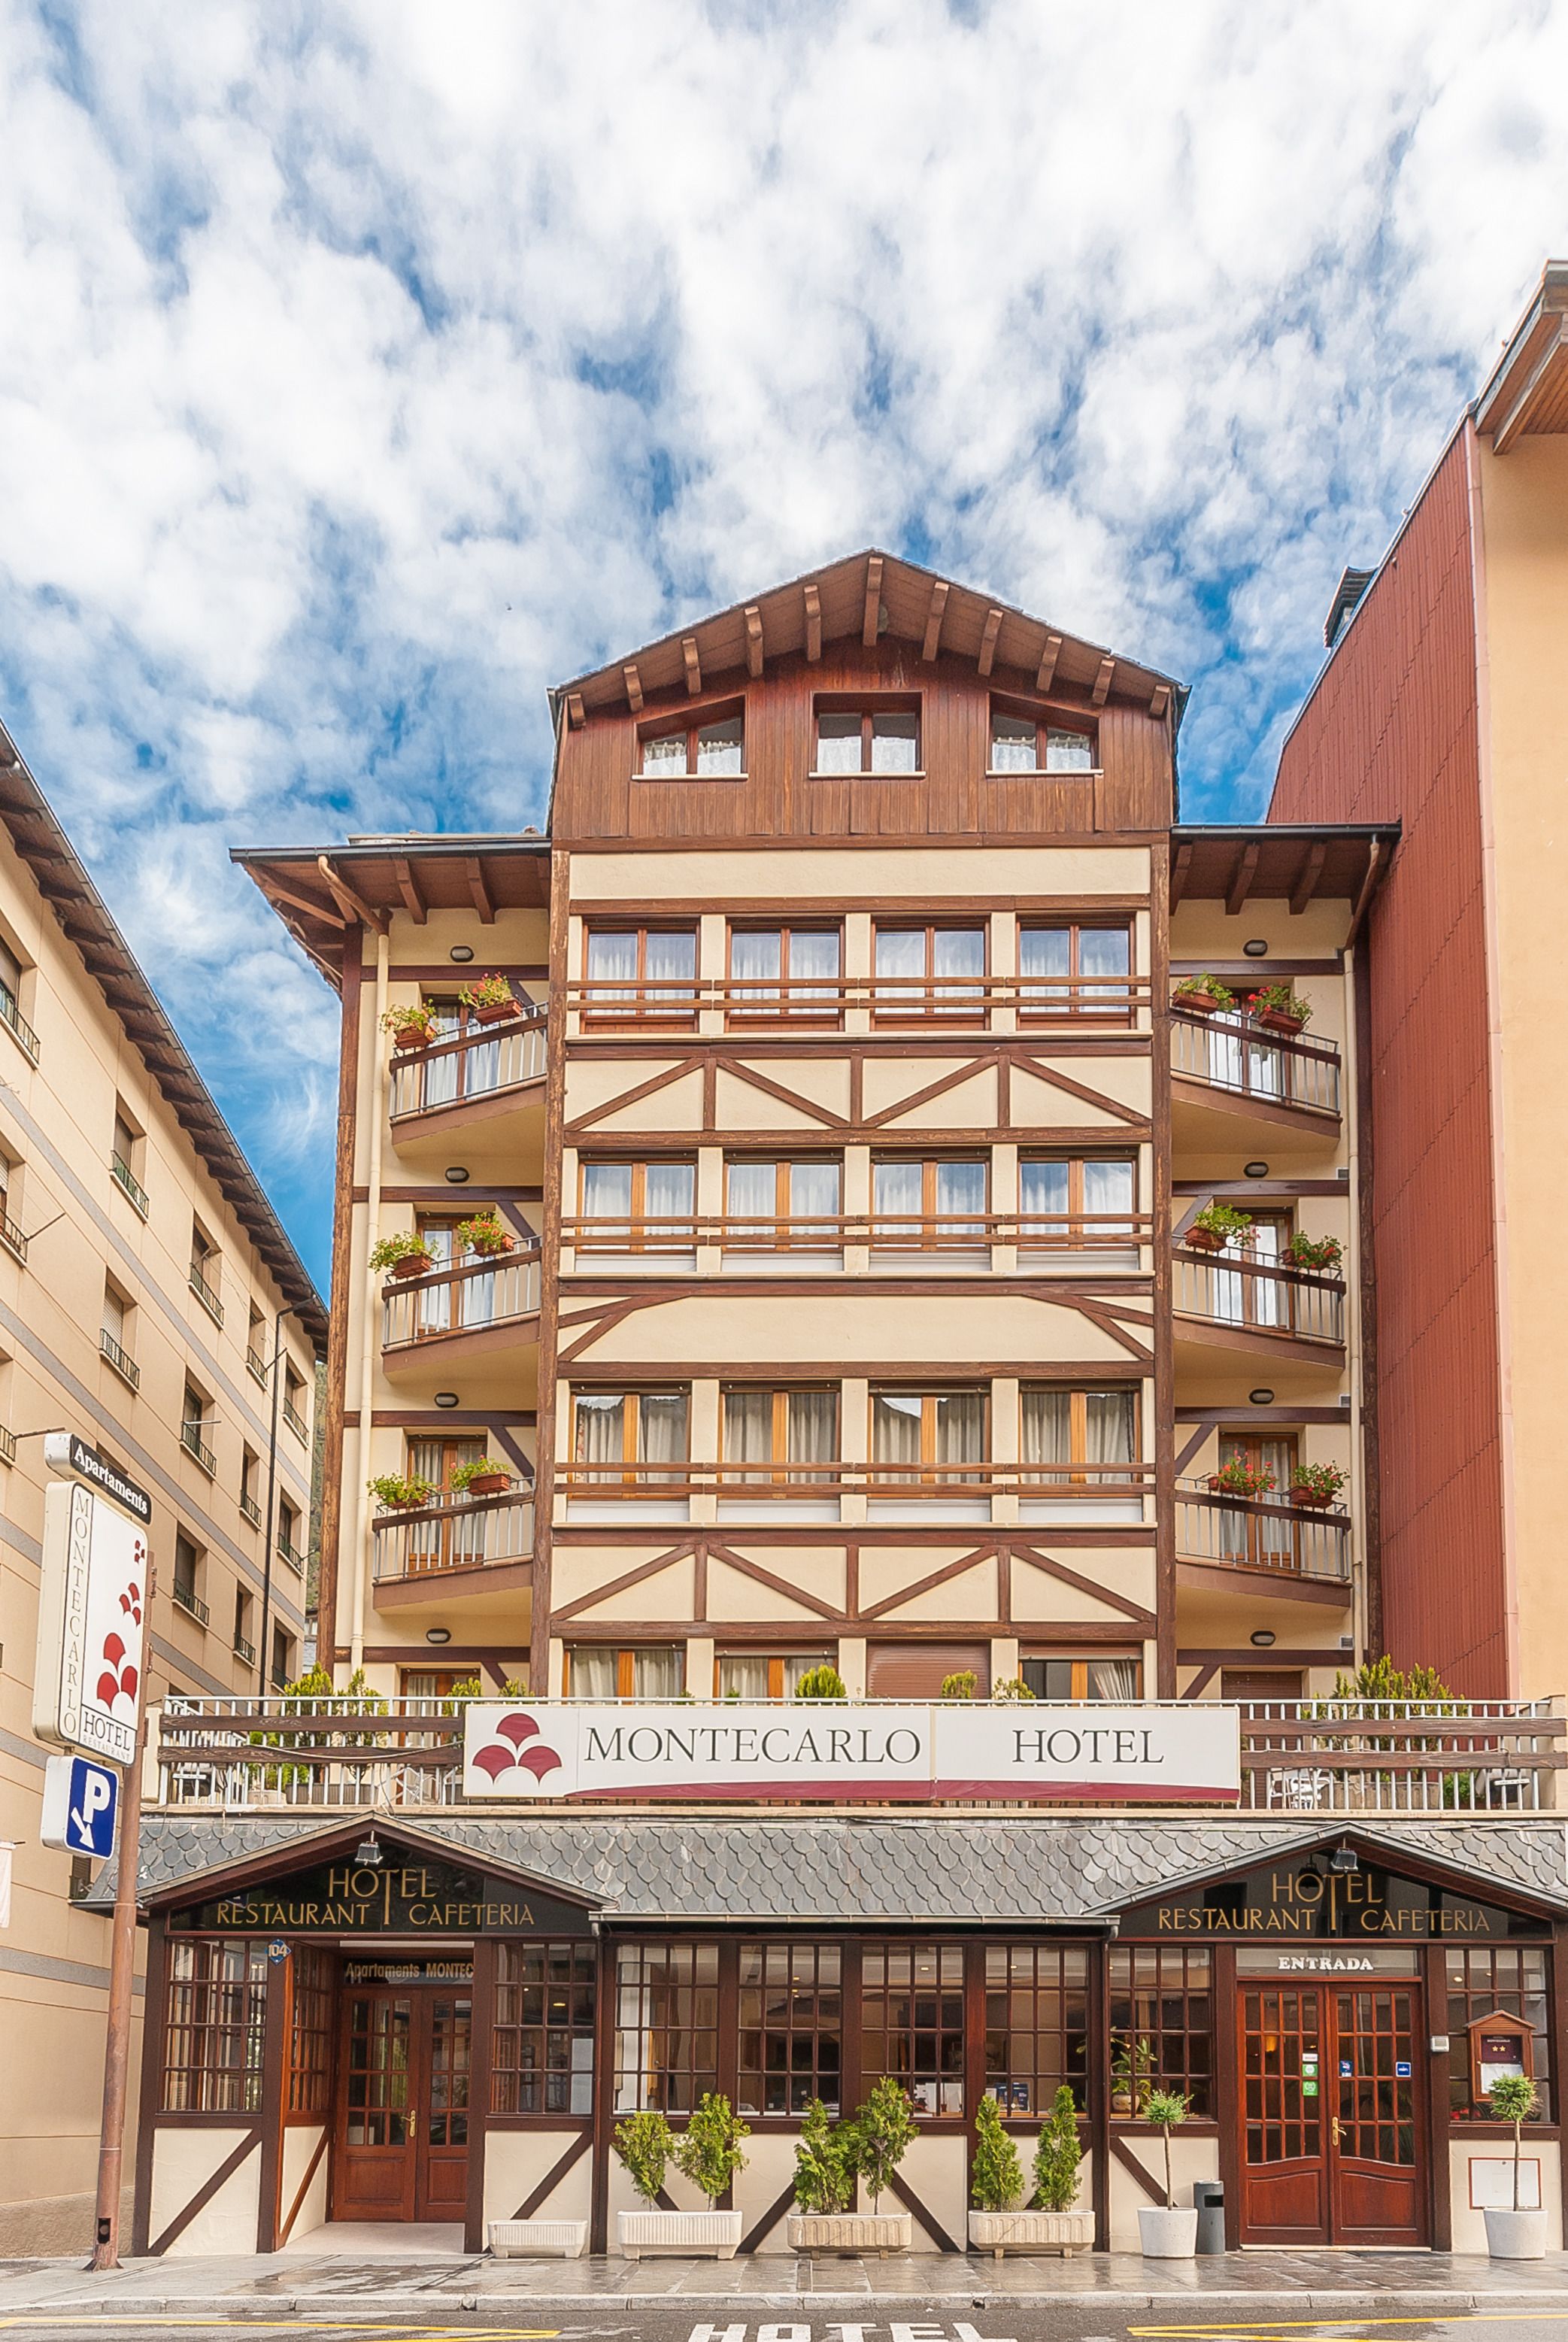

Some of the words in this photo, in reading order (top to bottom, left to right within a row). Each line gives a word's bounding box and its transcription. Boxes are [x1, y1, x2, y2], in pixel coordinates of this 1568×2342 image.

[74, 1443, 148, 1515] Apartaments
[63, 1491, 89, 1734] MONTECARLO
[83, 1711, 131, 1752] HOTEL
[83, 1734, 130, 1762] RESTAURANT
[584, 1726, 922, 1764] MONTECARLO
[1011, 1728, 1165, 1764] HOTEL
[83, 1769, 111, 1824] P
[328, 1868, 437, 1925] HOTEL
[1272, 1873, 1384, 1931] HOTEL
[217, 1903, 370, 1925] RESTAURANT
[408, 1904, 535, 1925] CAFETERIA
[1158, 1908, 1316, 1931] RESTAURANT
[1360, 1909, 1491, 1931] CAFETERIA
[268, 1943, 287, 1958] 104
[1278, 1957, 1374, 1971] ENTRADA
[345, 1962, 420, 1979] Apartaments
[687, 2322, 1018, 2342] HOTEL
